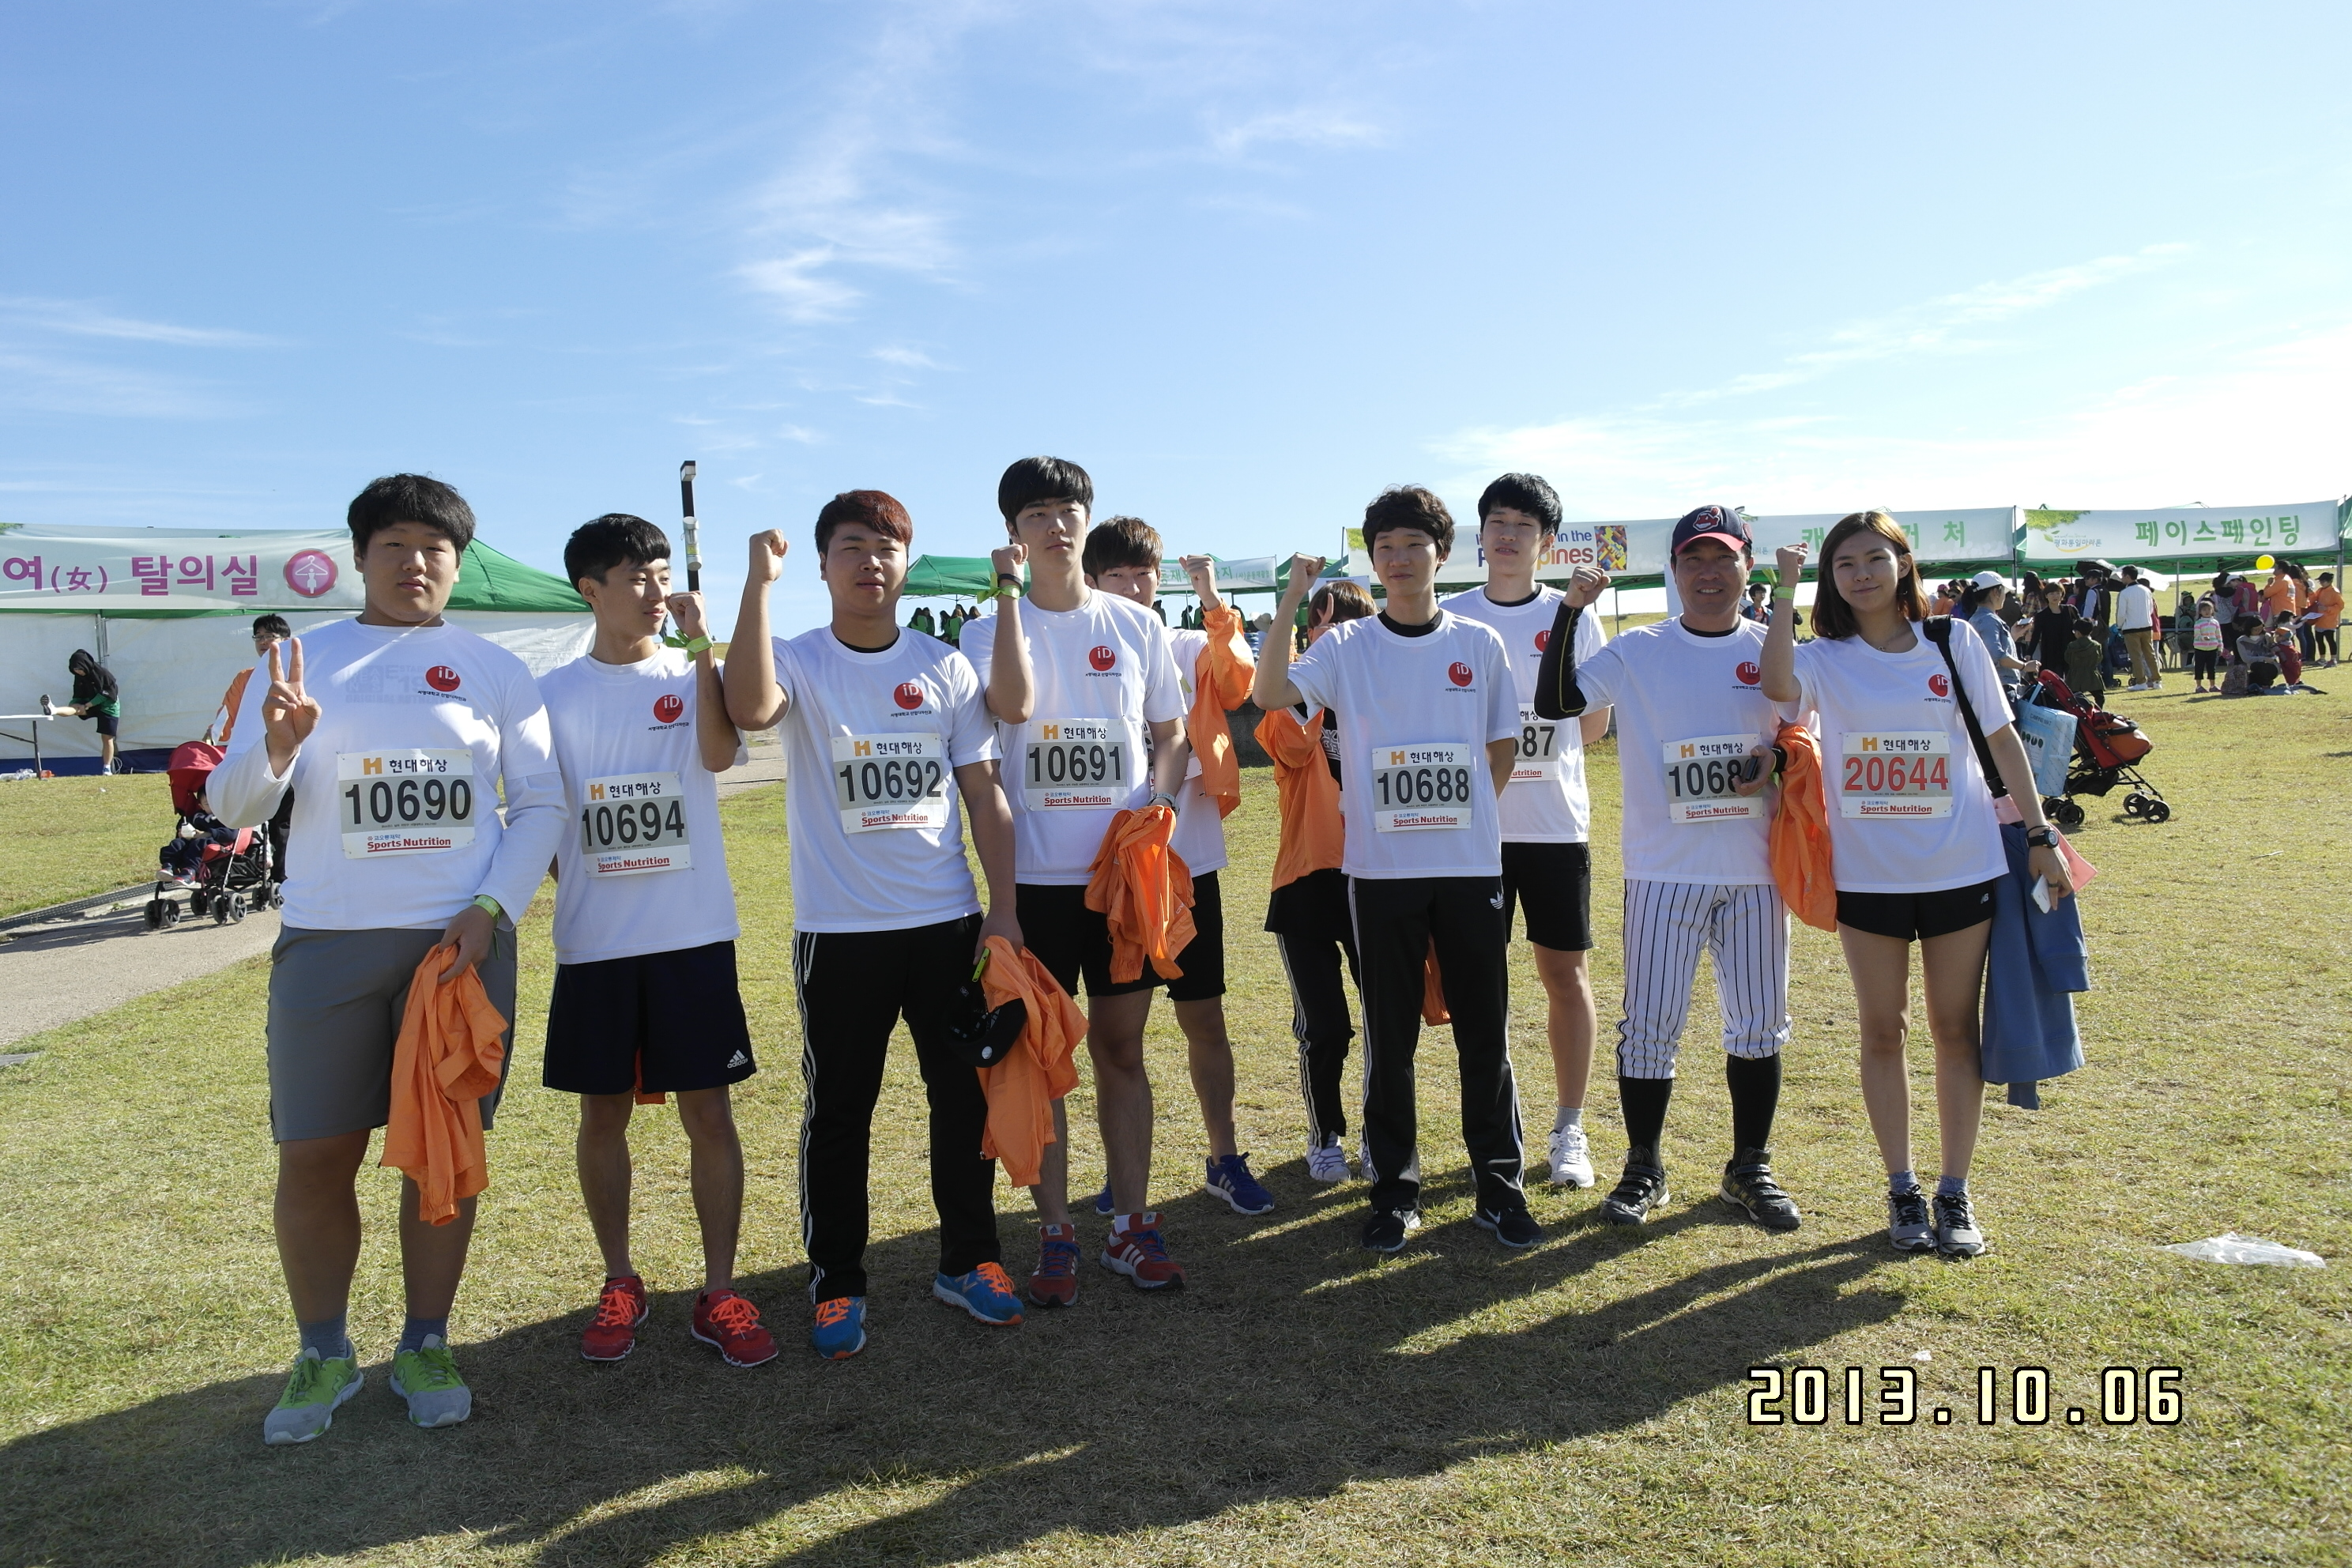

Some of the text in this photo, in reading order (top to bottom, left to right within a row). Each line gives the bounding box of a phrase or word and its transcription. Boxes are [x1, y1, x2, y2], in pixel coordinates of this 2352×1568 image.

[1558, 530, 1592, 542] in the
[2135, 515, 2299, 547] 페이스페인팅
[131, 555, 258, 596] 탈의실
[1097, 647, 1113, 658] iD
[438, 666, 457, 680] iD
[1456, 663, 1469, 675] iD
[1745, 663, 1758, 673] iD
[903, 684, 919, 696] iD
[664, 696, 680, 709] iD
[1064, 727, 1107, 739] 현대해상
[876, 741, 922, 755] 현대해상
[1699, 742, 1743, 756] 현대해상
[1883, 739, 1931, 751] 현대해상
[1029, 745, 1121, 782] 10691
[1410, 751, 1454, 763] 현대해상
[389, 759, 447, 773] 현대해상
[1668, 760, 1750, 797] 1068
[1845, 756, 1949, 791] 20644
[839, 760, 941, 802] 10692
[1378, 768, 1469, 805] 10688
[609, 782, 661, 798] 현대해상
[345, 779, 471, 824] 10690
[1044, 795, 1111, 805] Sports Nutrition
[862, 815, 891, 824] Sports
[1686, 808, 1712, 817] Sports
[582, 800, 684, 846] 10694
[1393, 817, 1419, 826] Sports
[368, 838, 451, 850] Sports Nutrition
[598, 857, 669, 871] Sports Nutrition
